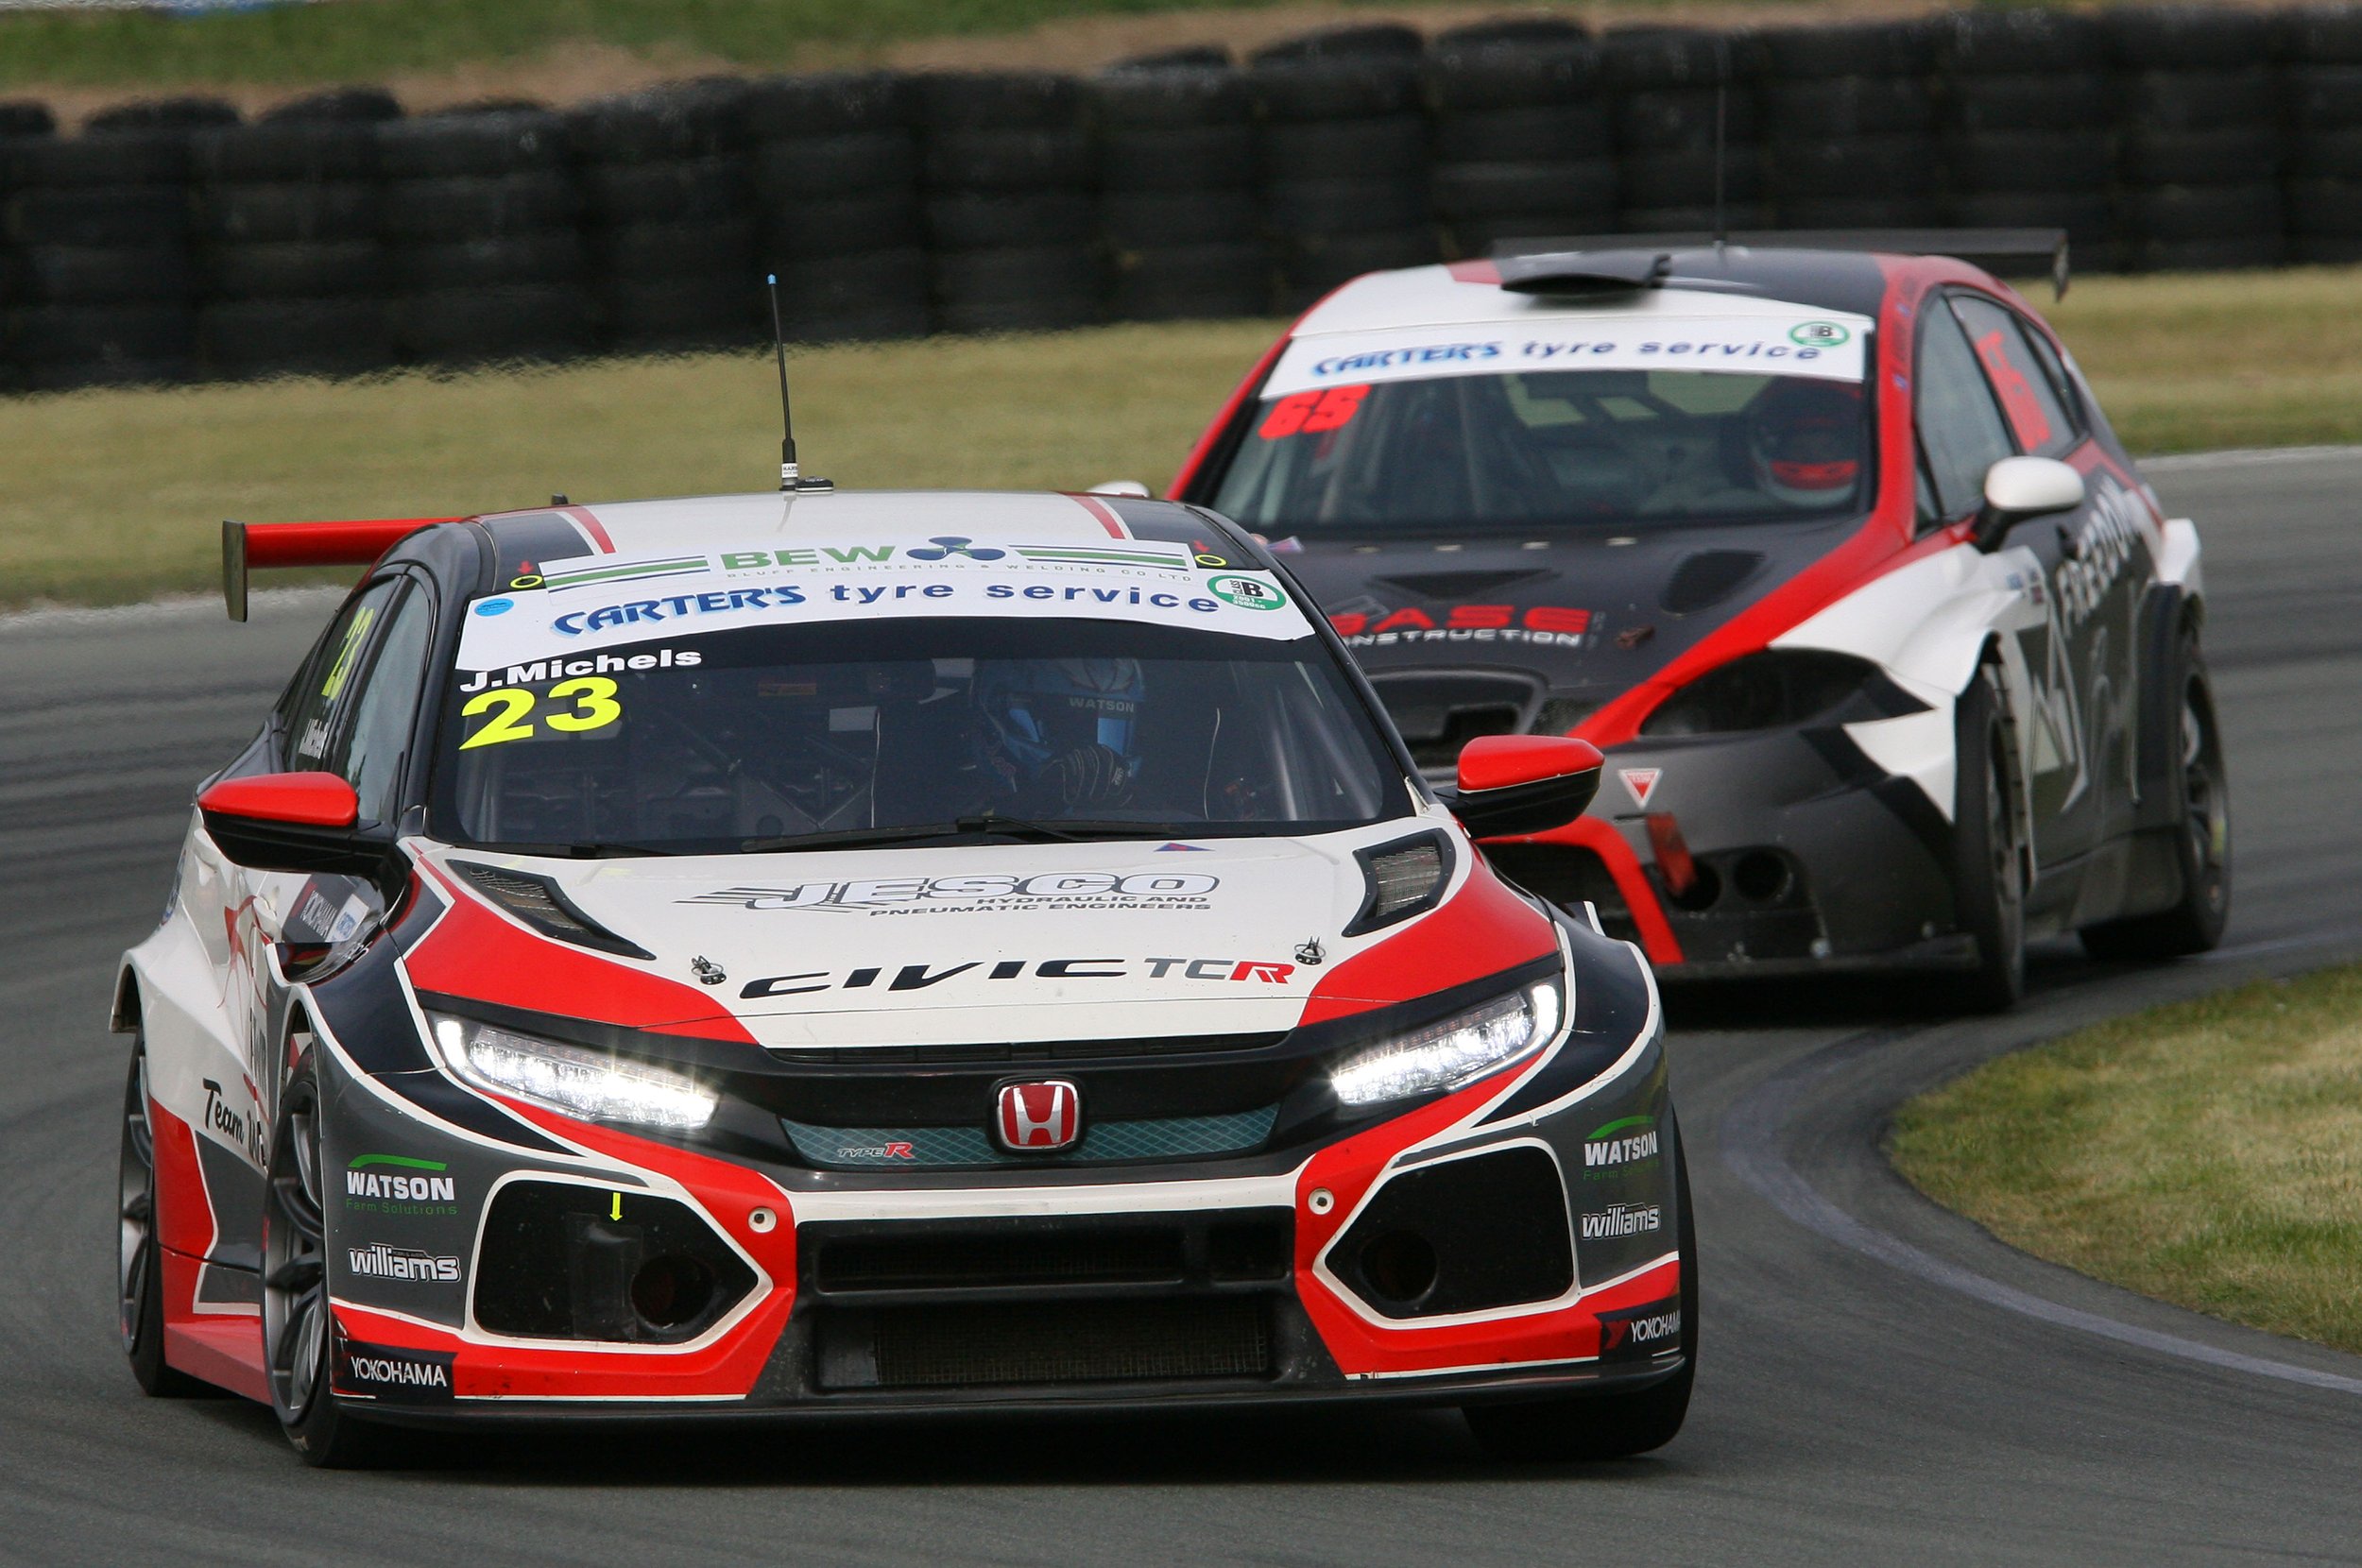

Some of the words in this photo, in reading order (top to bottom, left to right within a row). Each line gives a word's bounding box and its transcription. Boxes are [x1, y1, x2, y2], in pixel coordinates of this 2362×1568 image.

[1523, 340, 1617, 358] tyre
[1637, 341, 1821, 360] service
[1258, 383, 1372, 441] 65
[720, 546, 896, 570] BEW
[727, 570, 795, 578] BLUFF
[811, 564, 965, 572] ENGINEERING
[1006, 564, 1106, 574] WELDING
[1159, 573, 1192, 582] LTD
[1241, 581, 1264, 597] B
[552, 585, 807, 637] CARTER'S
[829, 584, 953, 605] tyre
[986, 585, 1219, 612] service
[459, 649, 702, 692] J.Michels
[459, 677, 621, 749] 23
[1069, 697, 1134, 712] WATSON
[745, 872, 1220, 910] JESCO
[977, 895, 1138, 905] HYDRAULIC
[869, 903, 1039, 916] PNEUMATIC
[1048, 902, 1211, 911] ENGINEERS
[740, 958, 1126, 998] CIVIC
[1144, 958, 1295, 984] TCR
[202, 1077, 245, 1146] Team
[1584, 1131, 1658, 1167] WATSON
[346, 1170, 455, 1202] WATSON
[346, 1198, 377, 1211] Farm
[381, 1202, 458, 1217] Solutions
[1582, 1205, 1660, 1239] williams
[349, 1244, 461, 1281] williams
[1631, 1309, 1681, 1342] YOKOHAM
[351, 1355, 447, 1388] YOKOHAMA
